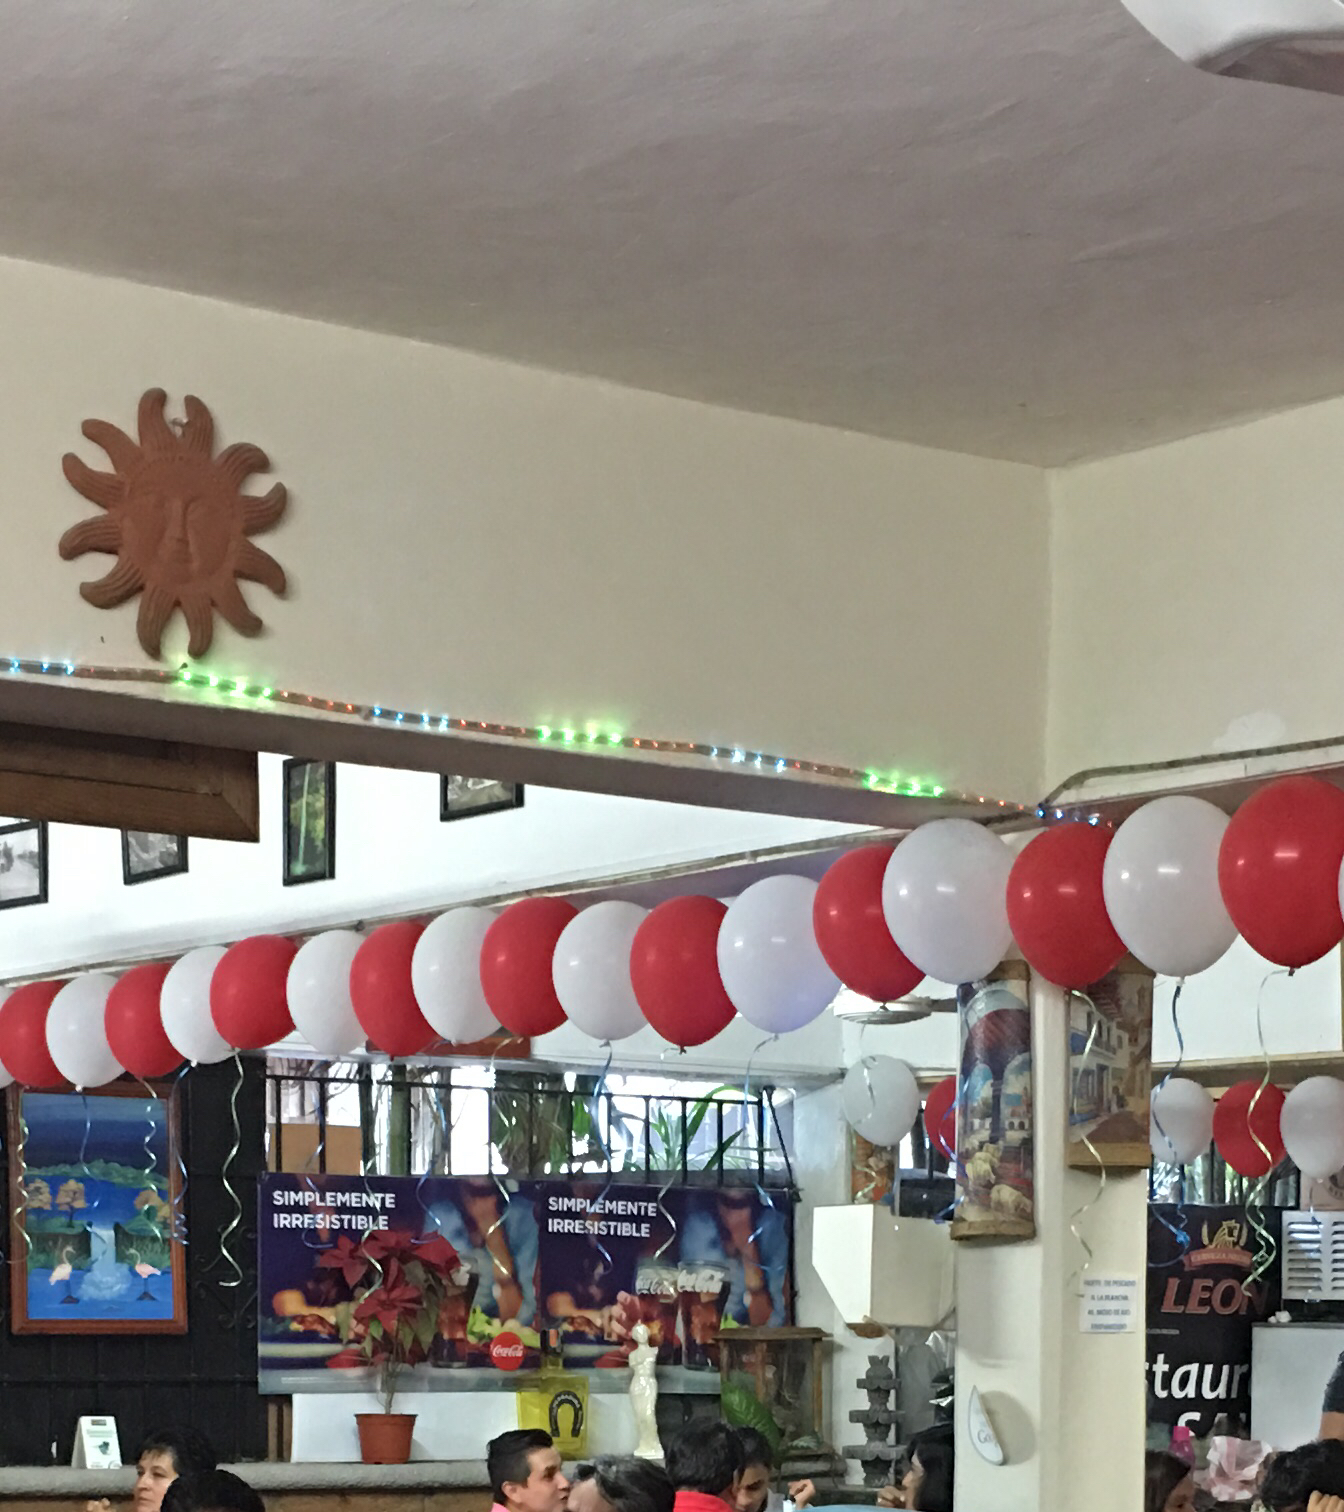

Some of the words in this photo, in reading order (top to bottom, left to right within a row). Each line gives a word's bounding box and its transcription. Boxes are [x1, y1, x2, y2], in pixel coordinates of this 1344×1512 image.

[272, 1190, 396, 1208] SIMPLEMENTE
[548, 1196, 657, 1217] SIMPLEMENTE
[273, 1213, 389, 1230] IRRESISTIBLE
[548, 1219, 651, 1238] IRRESISTIBLE
